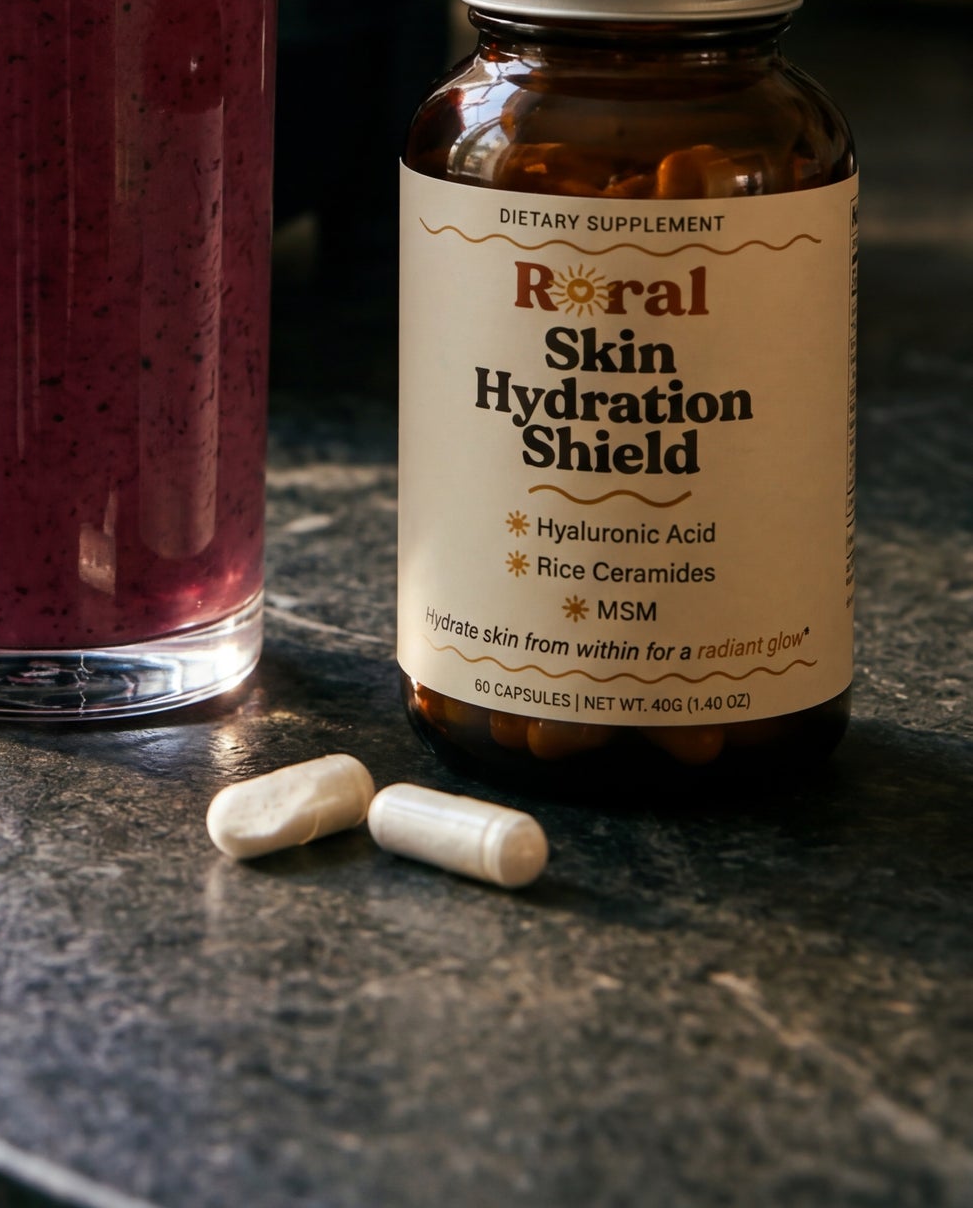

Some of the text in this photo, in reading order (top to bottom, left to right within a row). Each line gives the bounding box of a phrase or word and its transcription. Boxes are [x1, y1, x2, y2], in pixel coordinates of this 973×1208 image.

[500, 208, 725, 233] DIETARY SUPPLEMENT
[544, 326, 677, 374] Skin
[474, 366, 754, 427] Hydration
[521, 423, 701, 476] Shield
[537, 516, 716, 545] Hyaluronic Acid
[537, 555, 716, 584] Rice Ceramides
[597, 599, 657, 622] MSM
[425, 606, 479, 640] Hydrate
[483, 625, 519, 649] skin
[524, 632, 570, 656] from
[577, 639, 640, 661] within
[646, 641, 675, 661] for
[679, 645, 692, 660] a
[697, 637, 764, 660] radiant
[474, 678, 491, 694] 60
[494, 682, 571, 708] CAPSULES
[584, 695, 616, 711] NET
[620, 697, 648, 713] WT.
[651, 697, 683, 713] 40G
[687, 695, 723, 714] (1.40
[726, 692, 751, 711] OZ)
